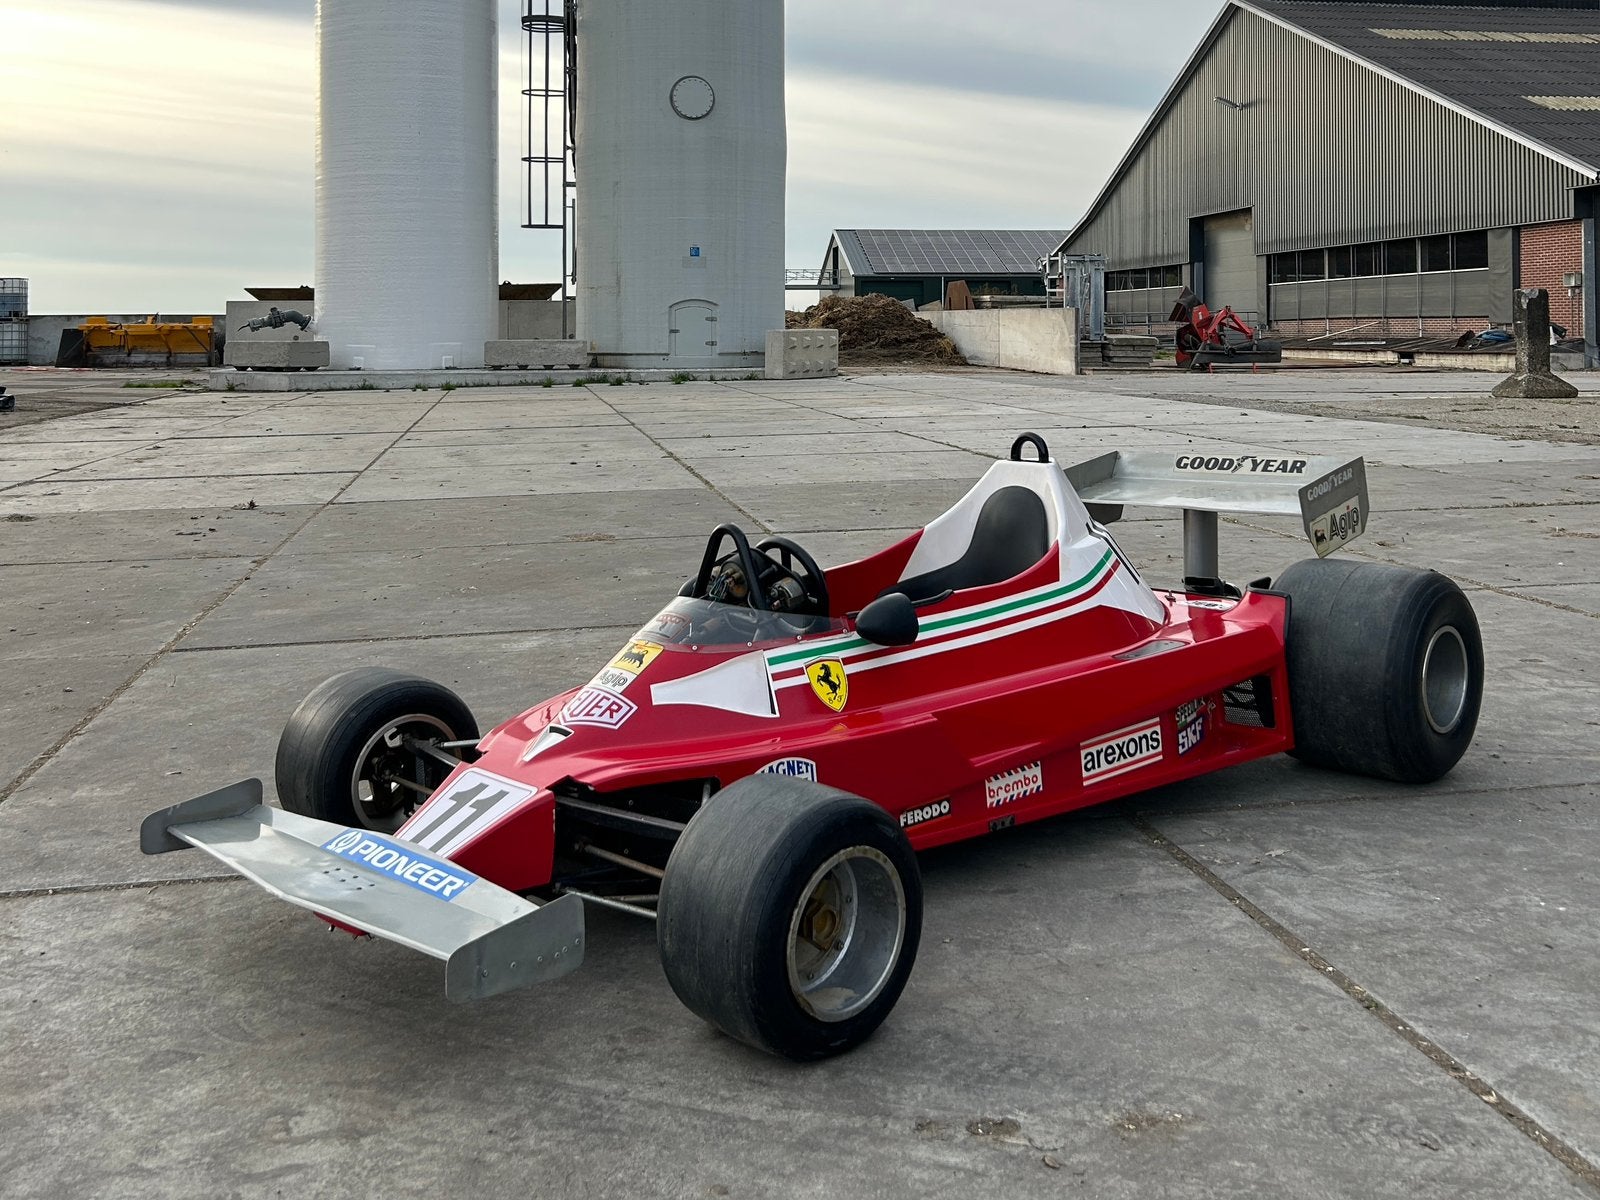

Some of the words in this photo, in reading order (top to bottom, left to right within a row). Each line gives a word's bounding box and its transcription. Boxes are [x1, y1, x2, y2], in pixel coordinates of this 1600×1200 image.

[1329, 505, 1360, 541] Agip
[1083, 728, 1160, 772] arexons
[1178, 717, 1203, 754] SKF
[761, 760, 814, 782] AGNETI
[408, 782, 510, 853] 11
[900, 800, 950, 826] FERODO
[349, 838, 467, 898] PIONEER
